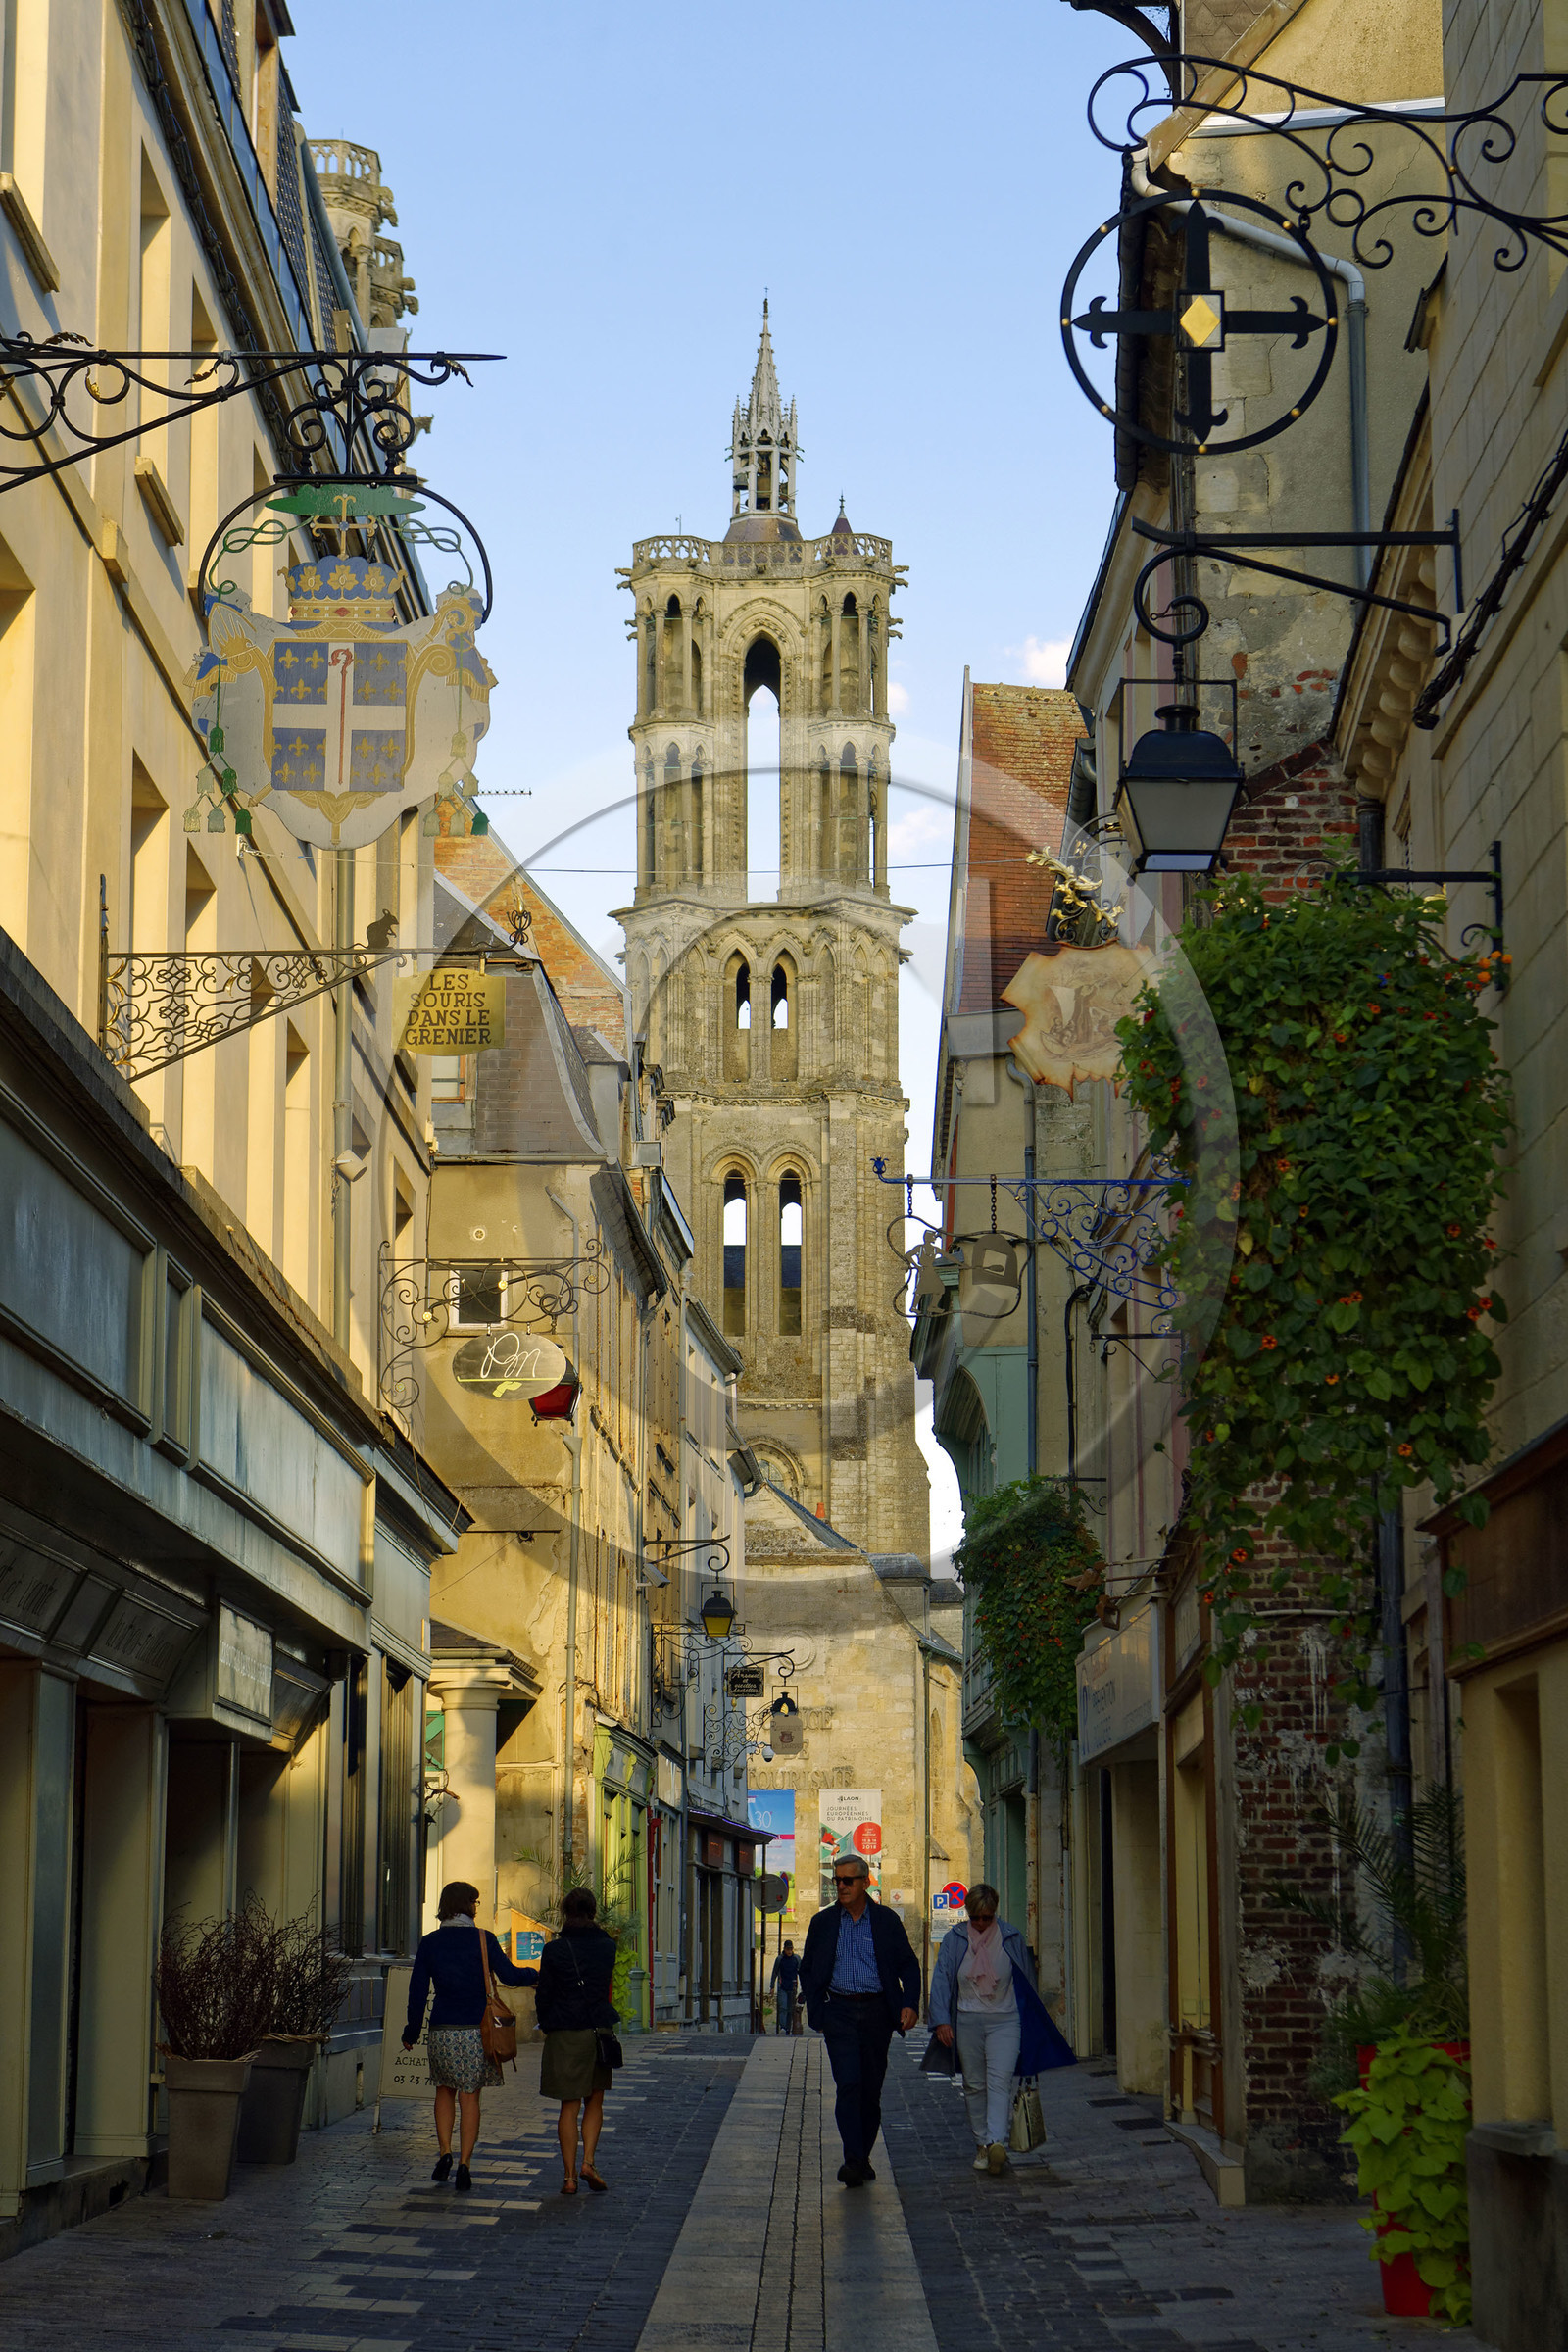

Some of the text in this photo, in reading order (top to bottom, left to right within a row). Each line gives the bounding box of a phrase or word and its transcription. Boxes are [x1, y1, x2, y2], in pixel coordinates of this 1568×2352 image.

[429, 974, 469, 991] LES
[410, 992, 486, 1008] SOURIS
[408, 1009, 490, 1027] DANS LE
[405, 1028, 492, 1046] GRENIER
[747, 1770, 854, 1790] TOURISME
[395, 2057, 428, 2067] ACHAT
[394, 2075, 405, 2084] 03
[409, 2075, 420, 2085] 23
